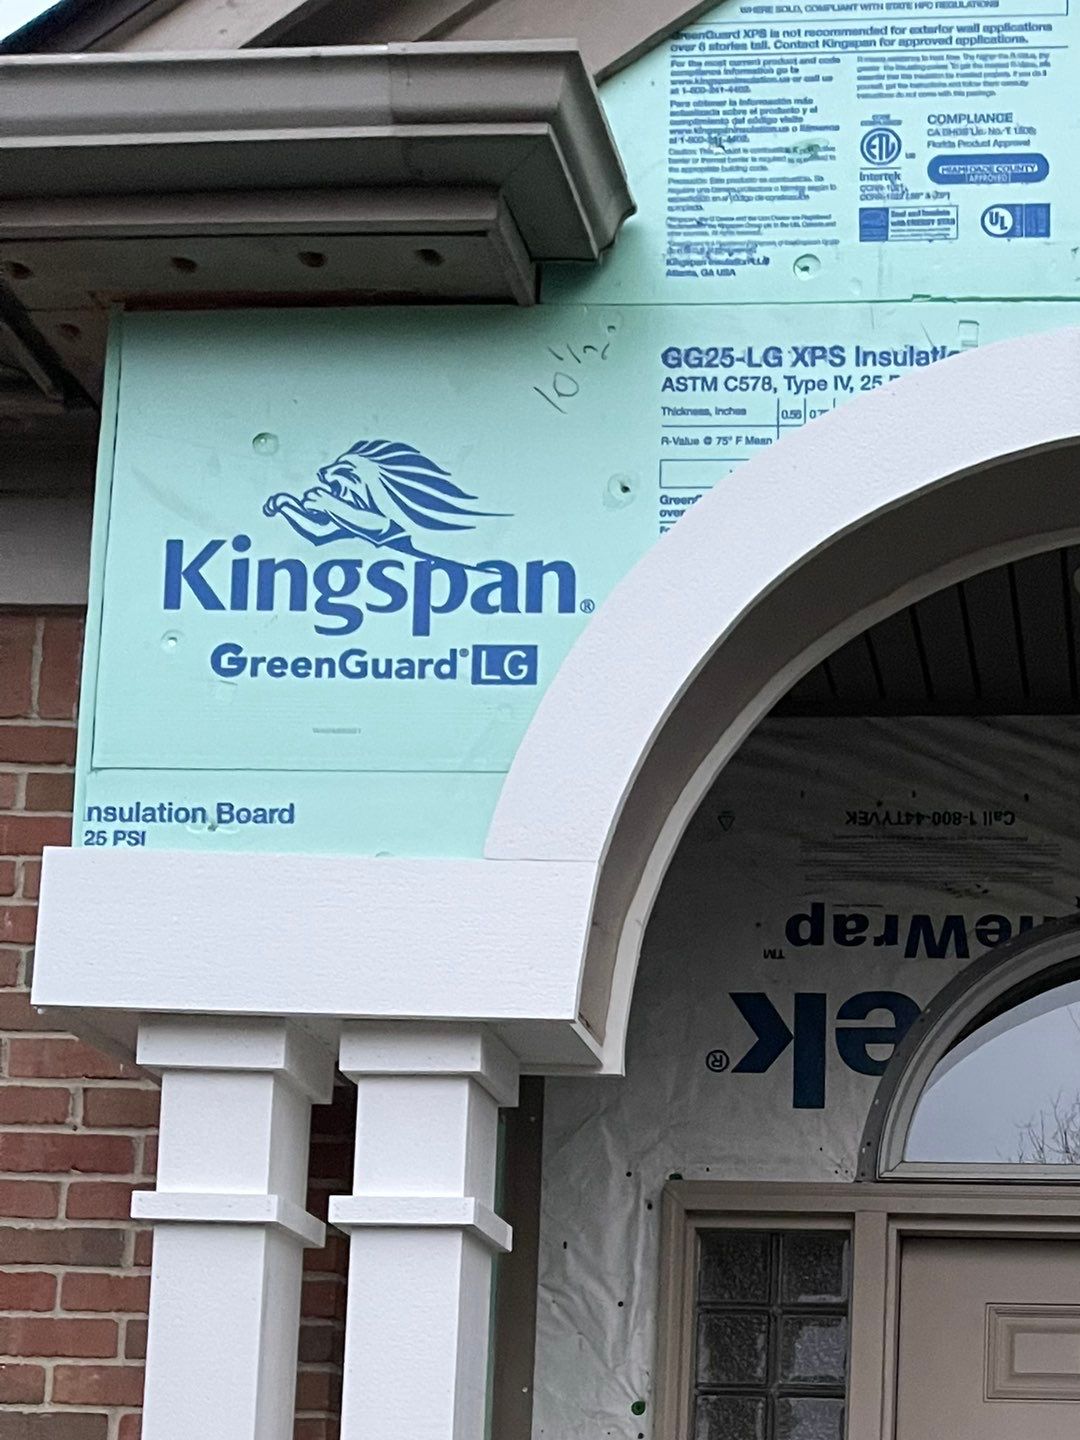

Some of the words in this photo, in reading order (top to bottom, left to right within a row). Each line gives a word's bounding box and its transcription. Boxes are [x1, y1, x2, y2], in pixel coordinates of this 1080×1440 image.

[861, 2, 883, 10] WITH
[743, 29, 767, 38] XPS
[770, 29, 779, 37] is
[783, 28, 801, 37] not
[804, 25, 887, 37] recommended
[891, 25, 906, 34] for
[910, 25, 954, 34] exterior
[956, 23, 979, 33] wall
[983, 23, 1052, 34] applications
[671, 43, 696, 52] over
[709, 41, 747, 50] stories
[774, 40, 819, 49] Contact
[822, 38, 877, 50] Kingspan
[880, 36, 895, 46] for
[899, 36, 952, 47] approved
[956, 35, 1028, 46] applications.
[927, 113, 1012, 124] COMPLIANCE
[859, 172, 902, 181] Intertek
[661, 346, 782, 368] GG25-LG
[790, 345, 846, 367] XPS
[661, 377, 718, 392] ASTM
[724, 376, 777, 393] C578,
[784, 375, 827, 394] Type
[834, 375, 854, 393] IV,
[661, 407, 712, 416] Thickness,
[661, 437, 699, 445] R-Value
[736, 437, 742, 445] F
[745, 436, 772, 445] Mean
[477, 648, 534, 683] LG
[217, 803, 294, 824] Board
[845, 810, 978, 827] 1-800-44TYVEK
[982, 810, 1015, 826] Call
[84, 830, 107, 846] 25
[113, 830, 146, 846] PSI
